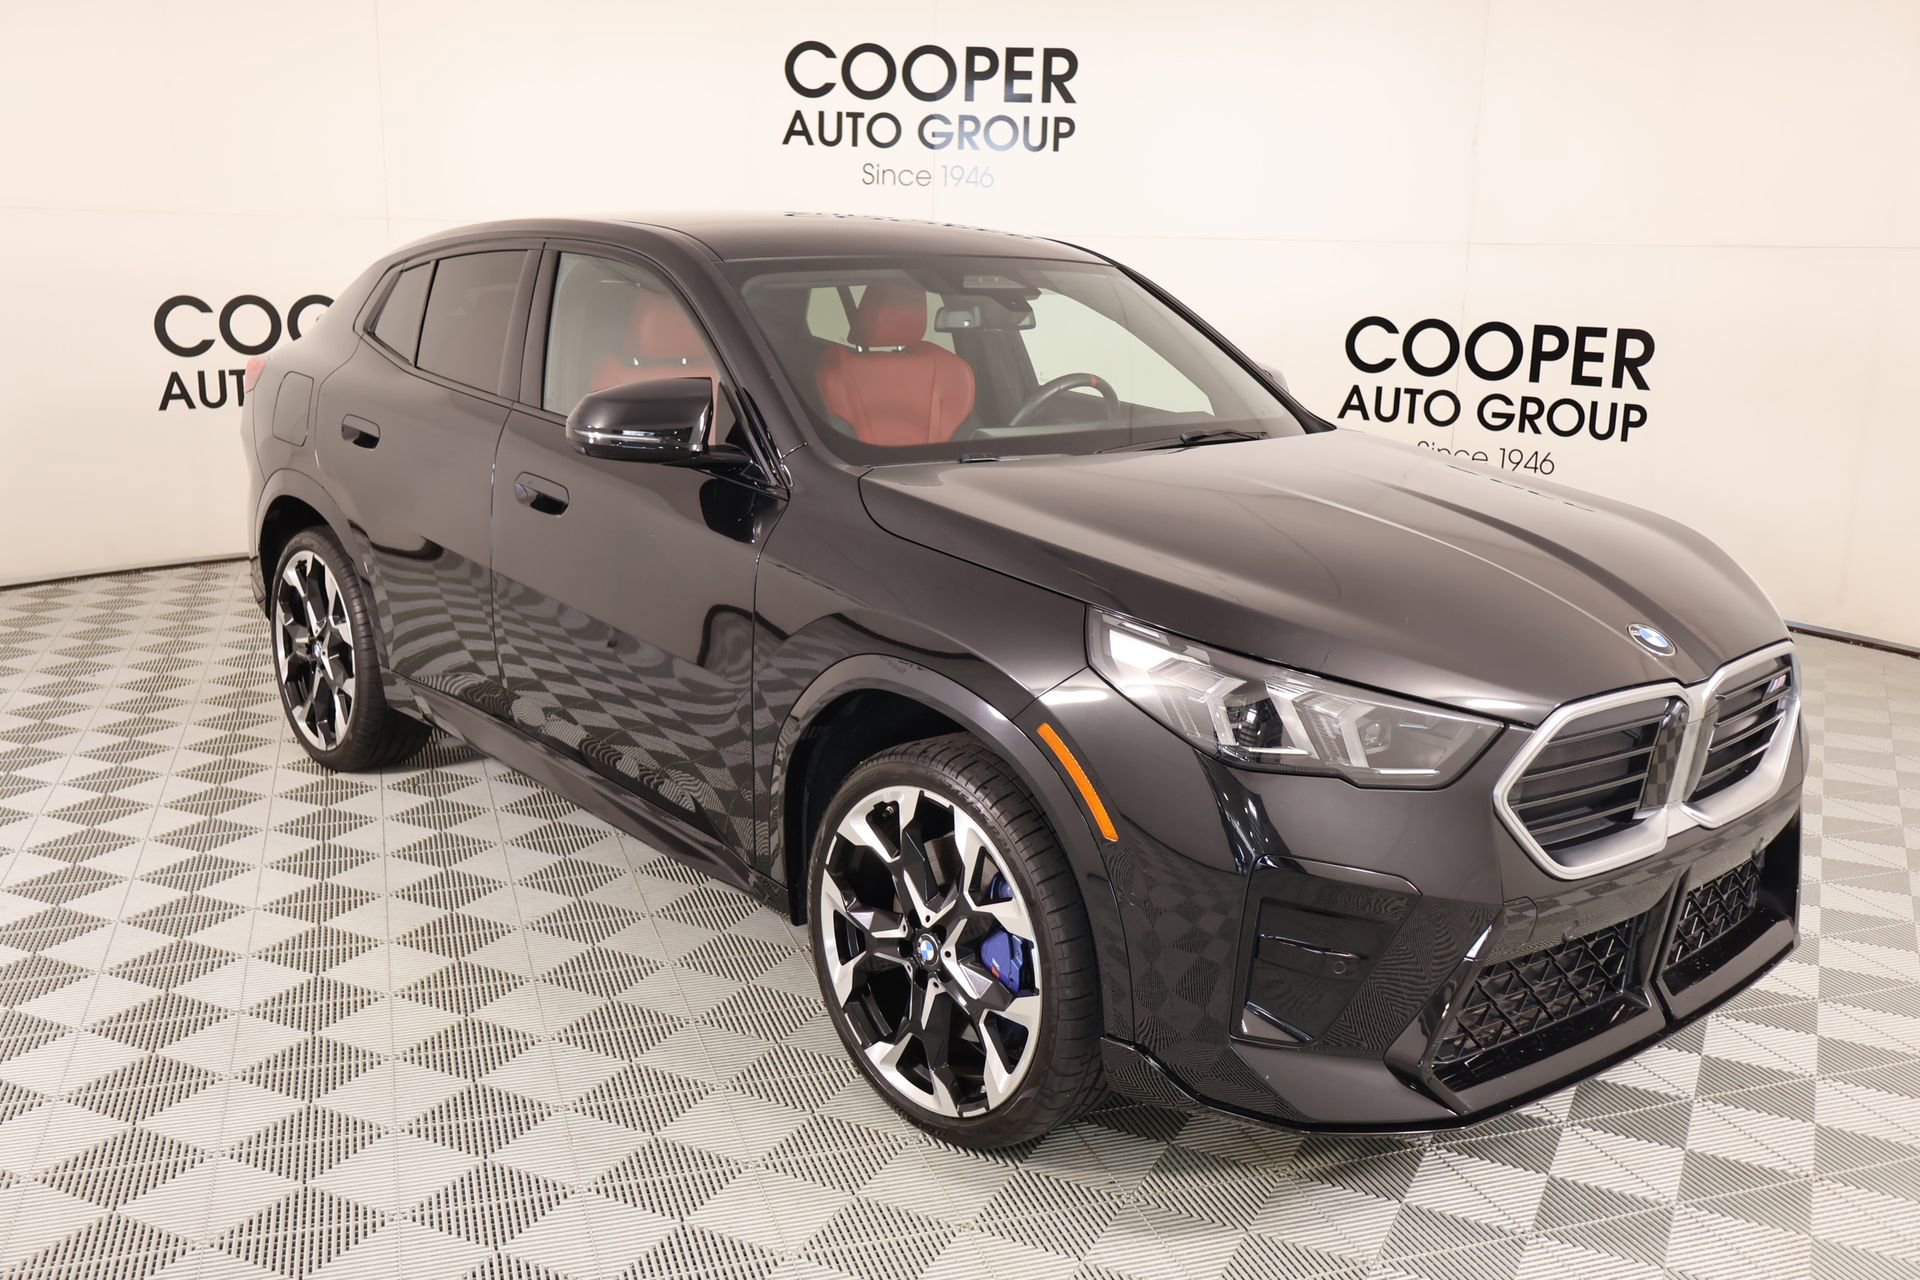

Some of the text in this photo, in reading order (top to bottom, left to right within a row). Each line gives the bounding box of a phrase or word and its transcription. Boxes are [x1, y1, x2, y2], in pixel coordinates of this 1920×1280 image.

[784, 40, 1079, 104] COOPER
[782, 109, 1076, 153] AUTO GROUP
[861, 162, 995, 189] Since 1946
[1344, 315, 1656, 391] COOPER
[1337, 384, 1648, 443] AUTO GROUP
[1499, 447, 1556, 476] 1946
